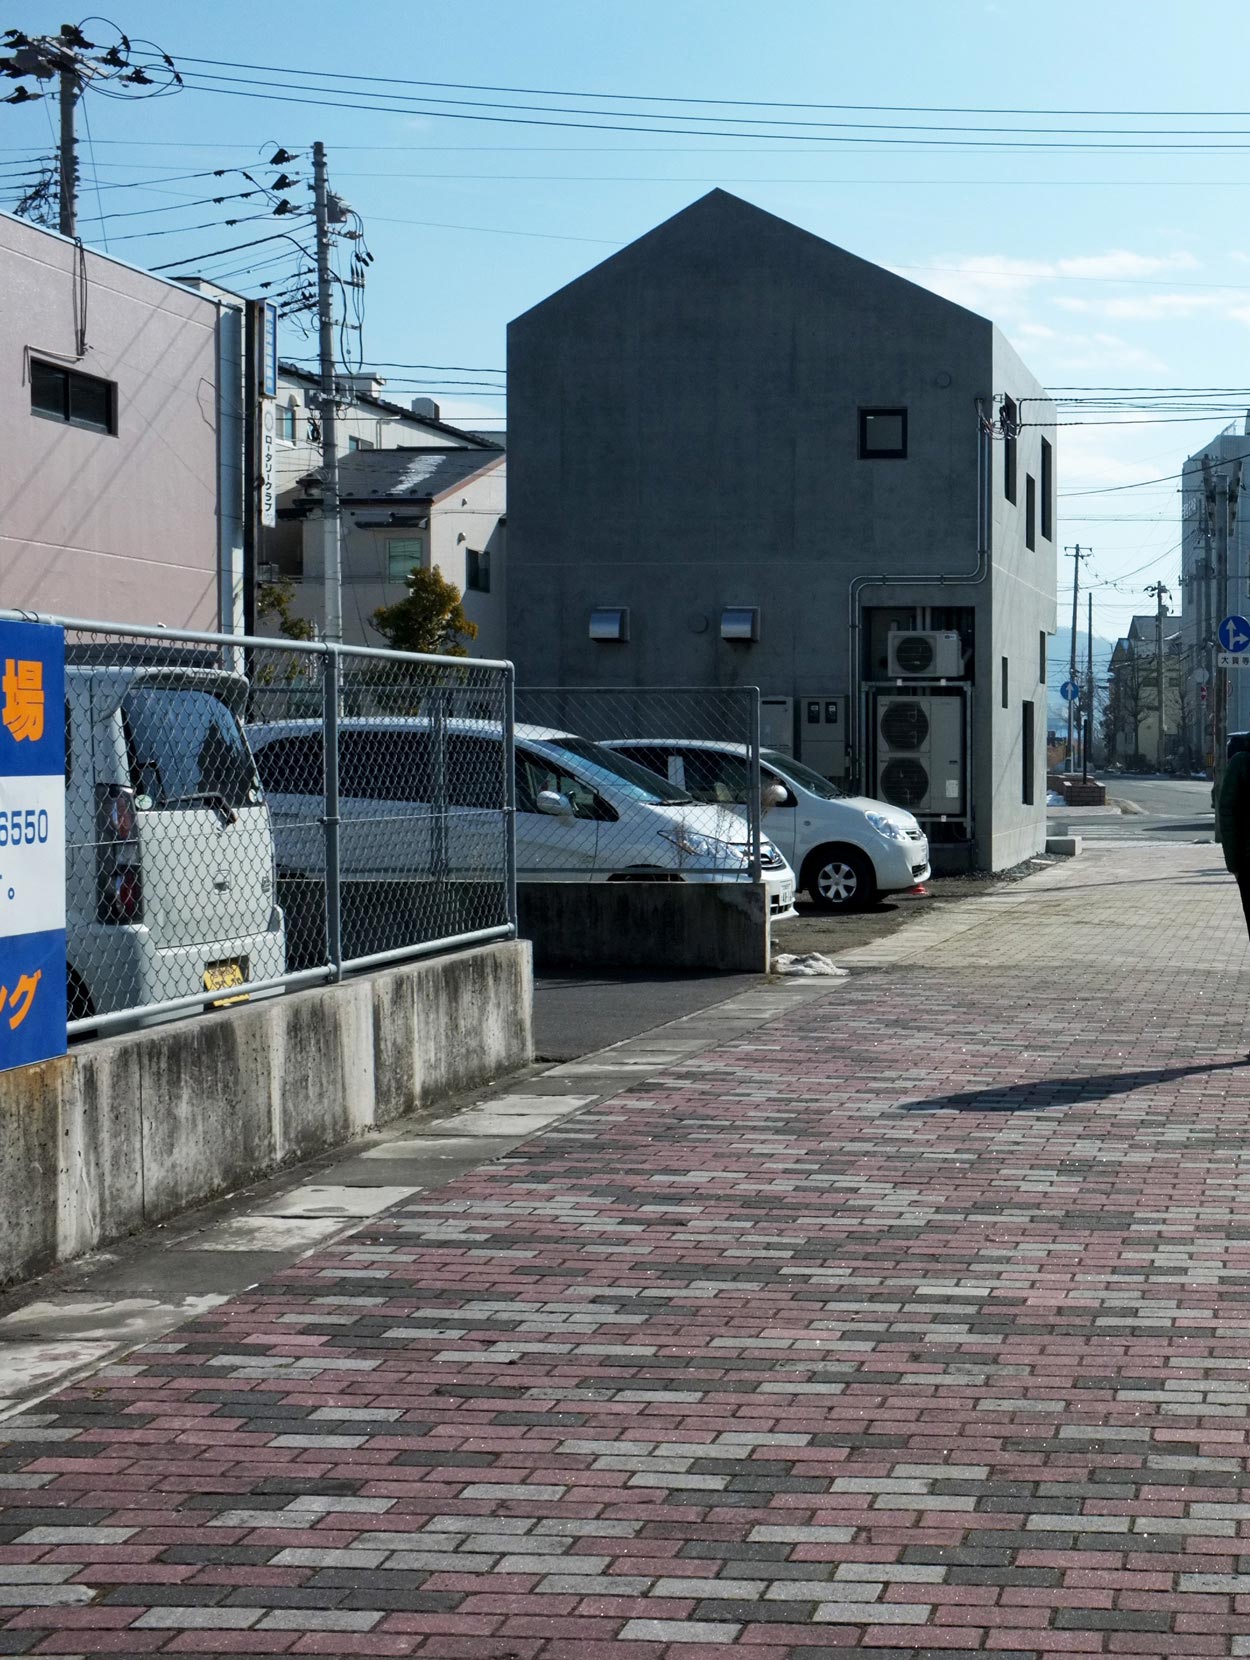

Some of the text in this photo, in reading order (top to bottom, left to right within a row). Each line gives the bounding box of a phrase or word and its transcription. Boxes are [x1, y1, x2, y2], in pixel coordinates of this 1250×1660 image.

[2, 658, 45, 742] 場
[0, 808, 49, 847] 6550
[0, 968, 42, 1031] グ
